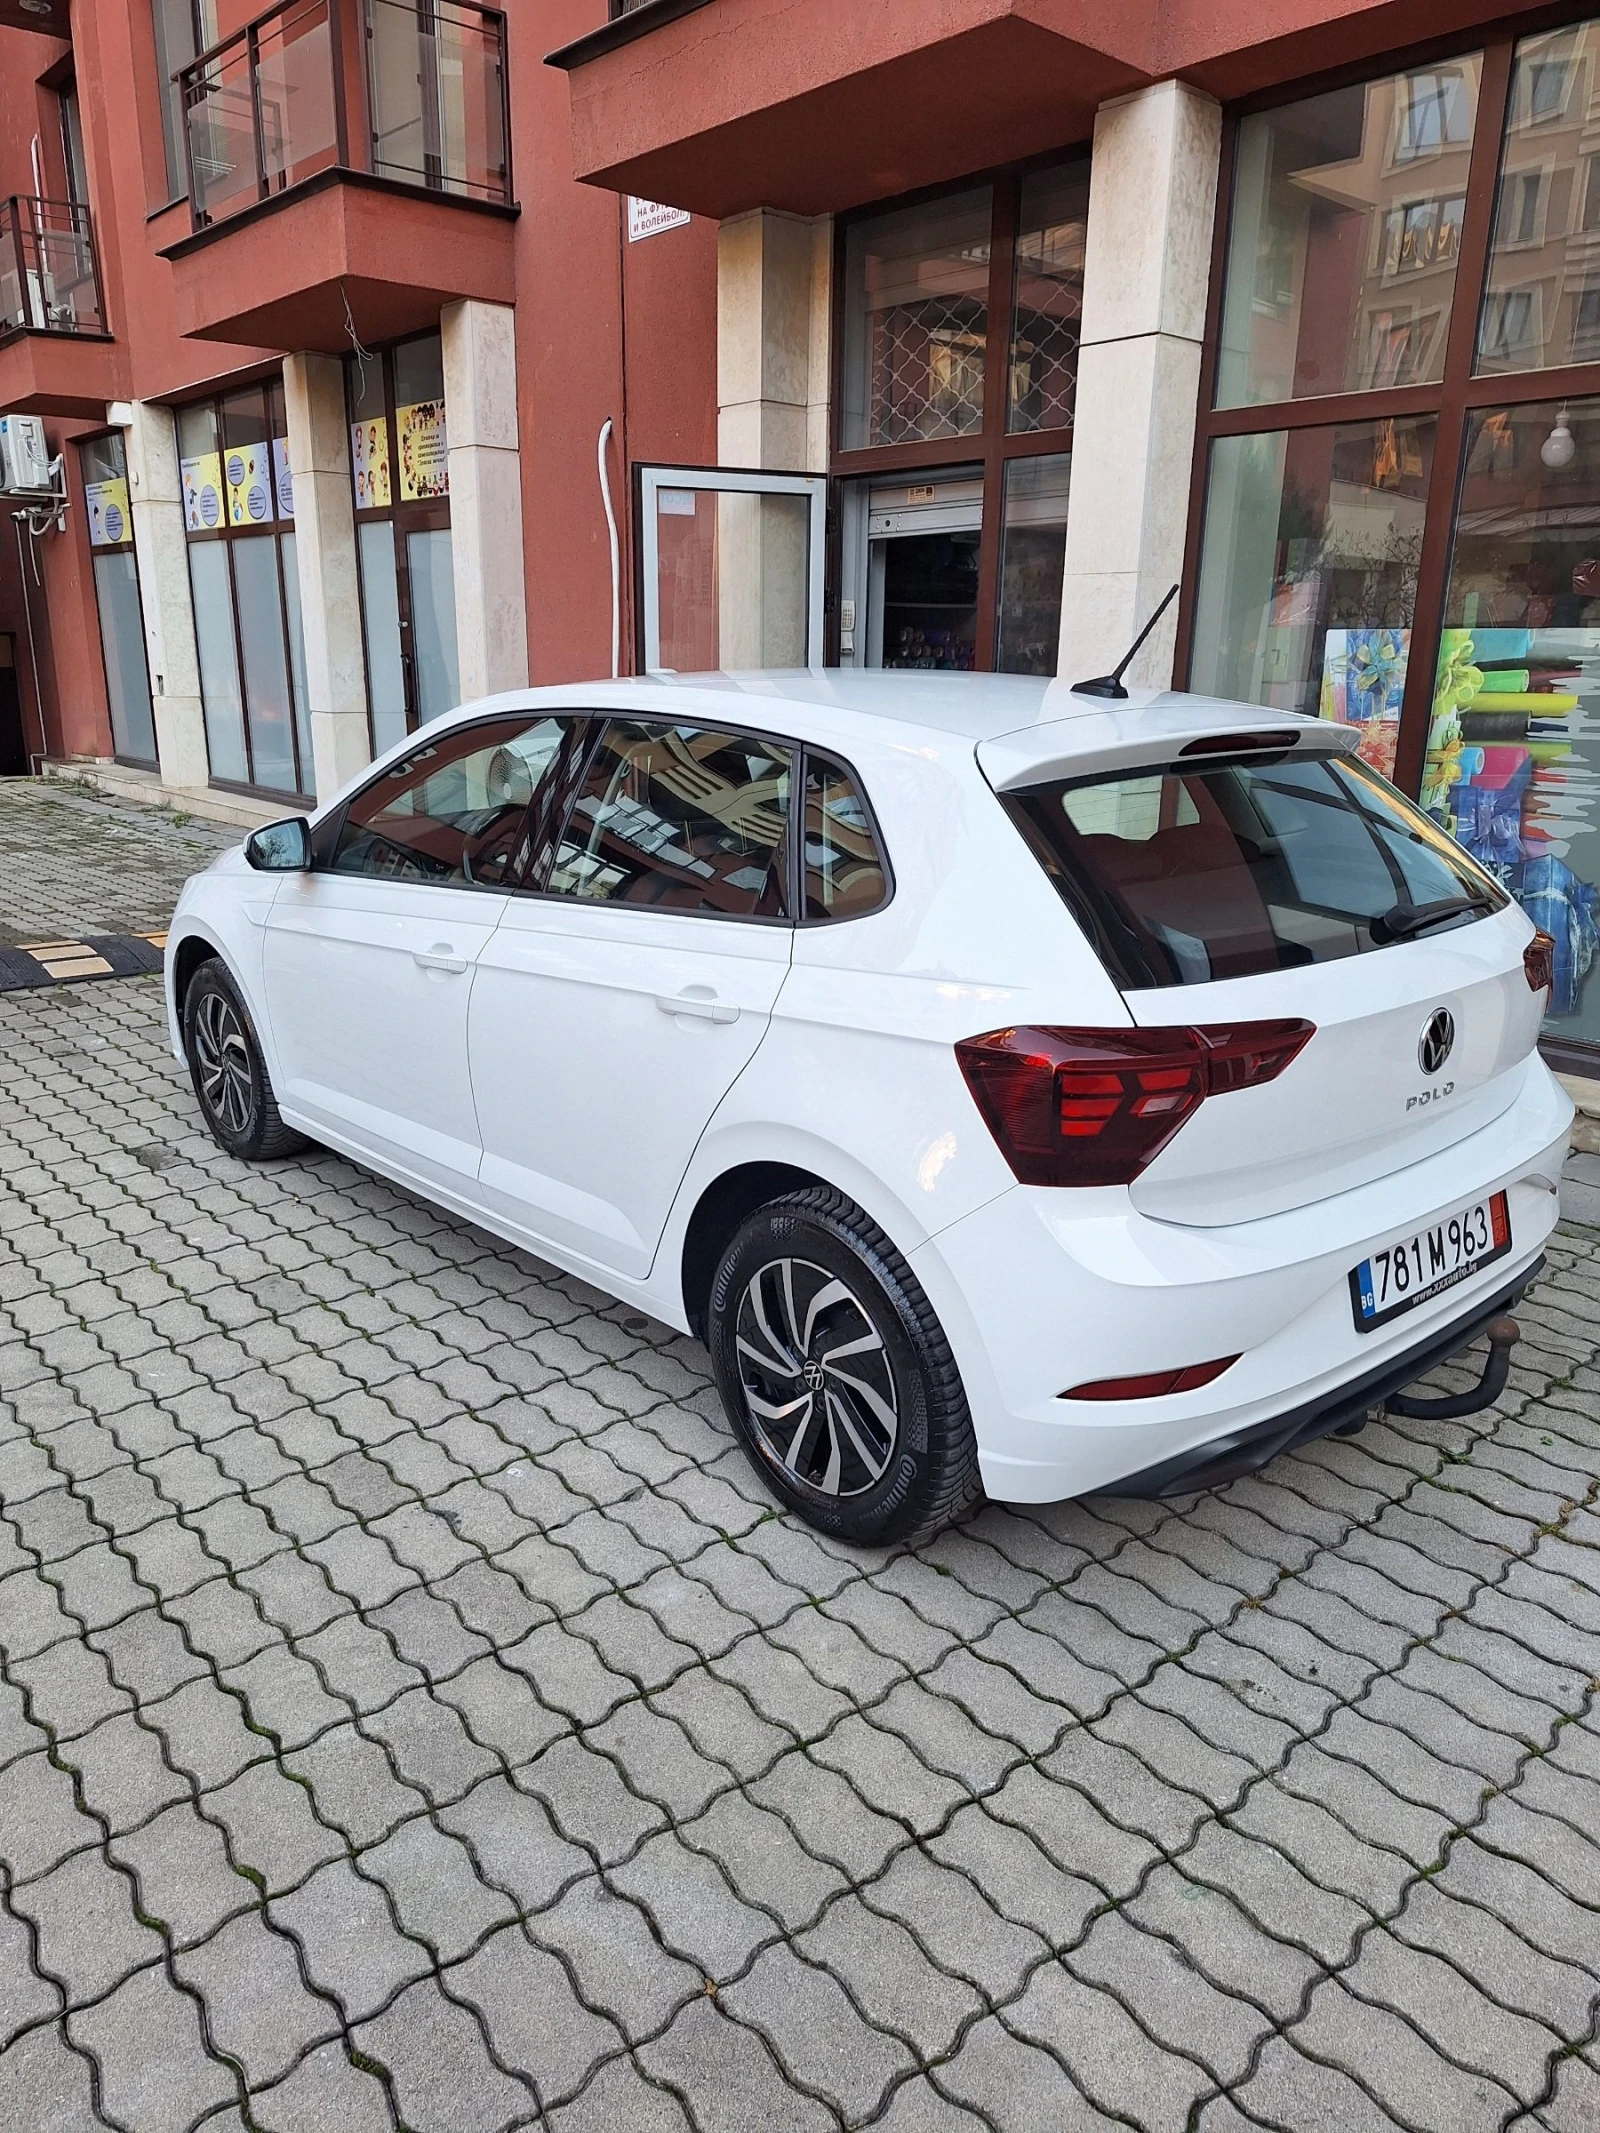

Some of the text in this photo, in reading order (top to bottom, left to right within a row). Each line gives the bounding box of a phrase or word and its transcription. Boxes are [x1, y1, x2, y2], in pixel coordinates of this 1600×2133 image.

[637, 207, 648, 218] НА
[633, 223, 639, 232] И
[1405, 1081, 1455, 1112] POLO
[1361, 1292, 1373, 1310] BG
